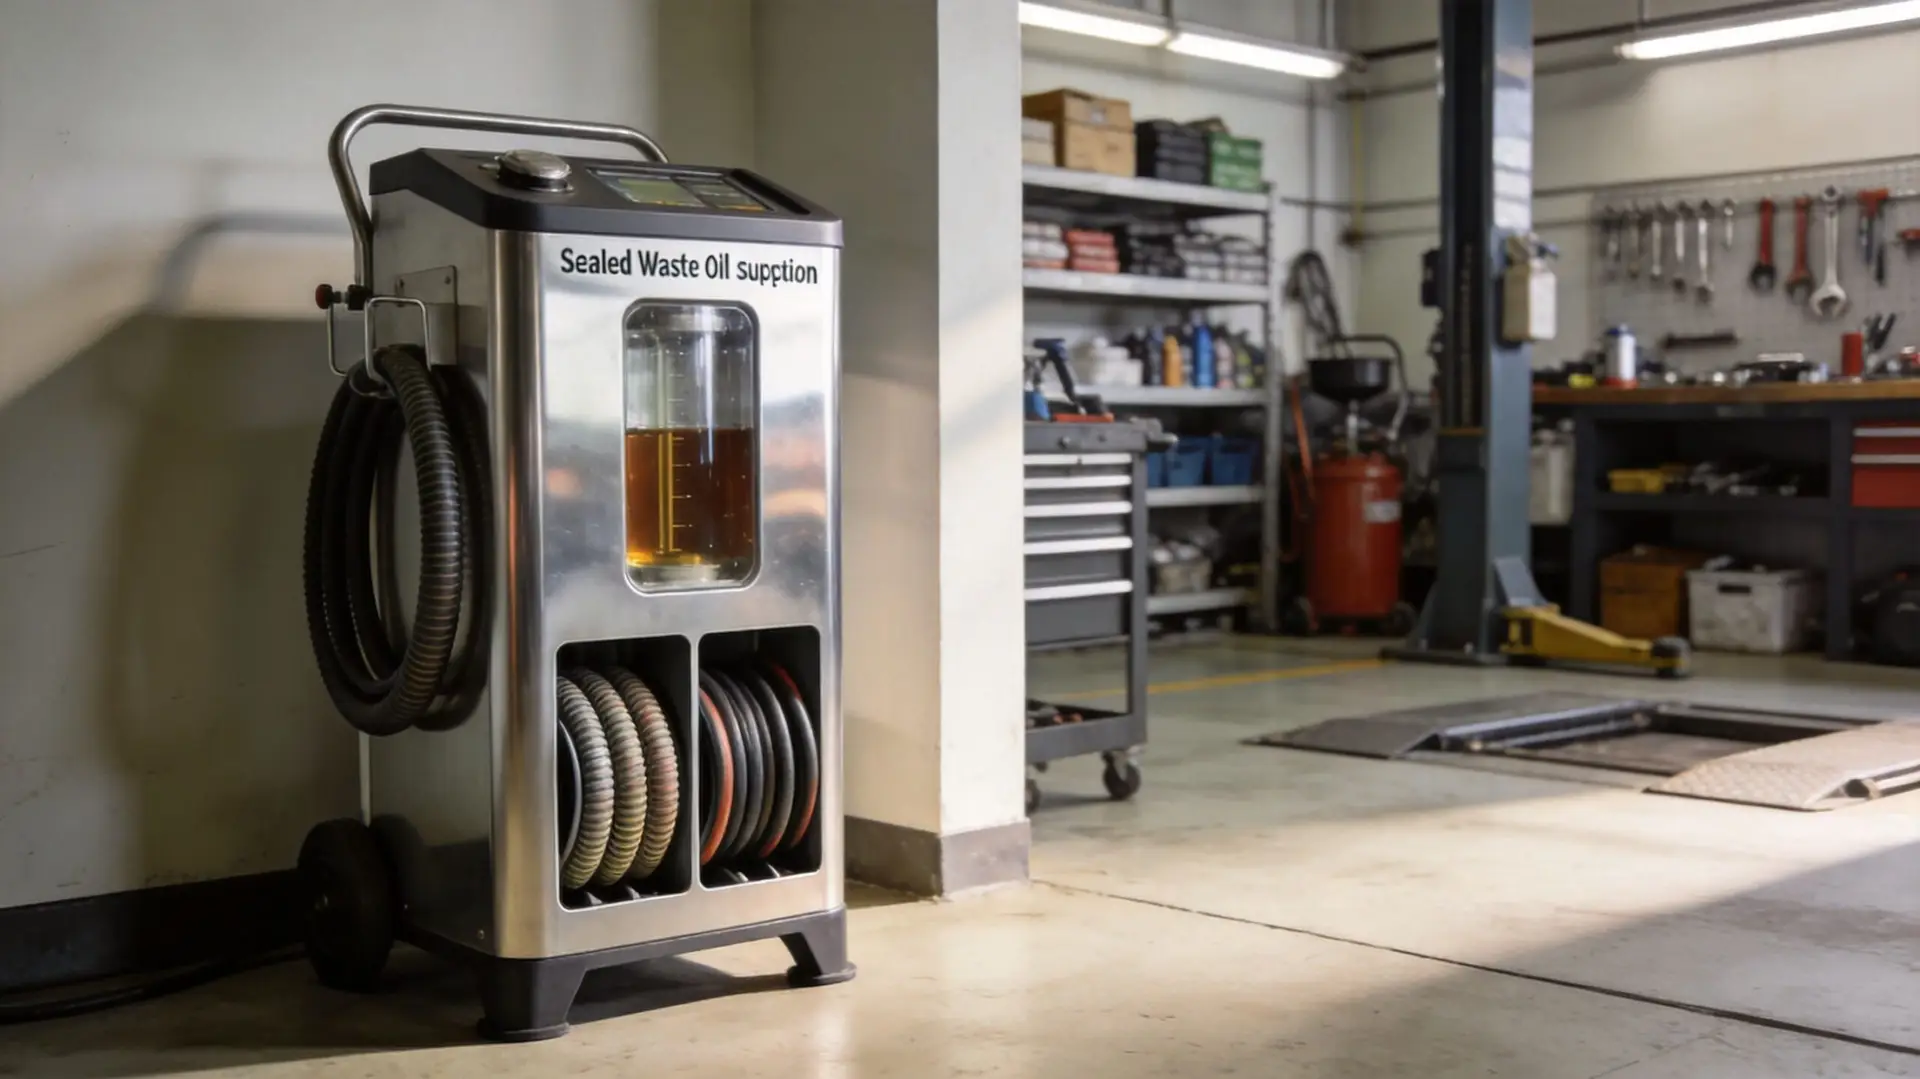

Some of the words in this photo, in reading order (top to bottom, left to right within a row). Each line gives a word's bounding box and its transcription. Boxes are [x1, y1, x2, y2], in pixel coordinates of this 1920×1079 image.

[560, 247, 632, 275] Sealed
[637, 250, 699, 278] Waste
[705, 253, 729, 280] Oil
